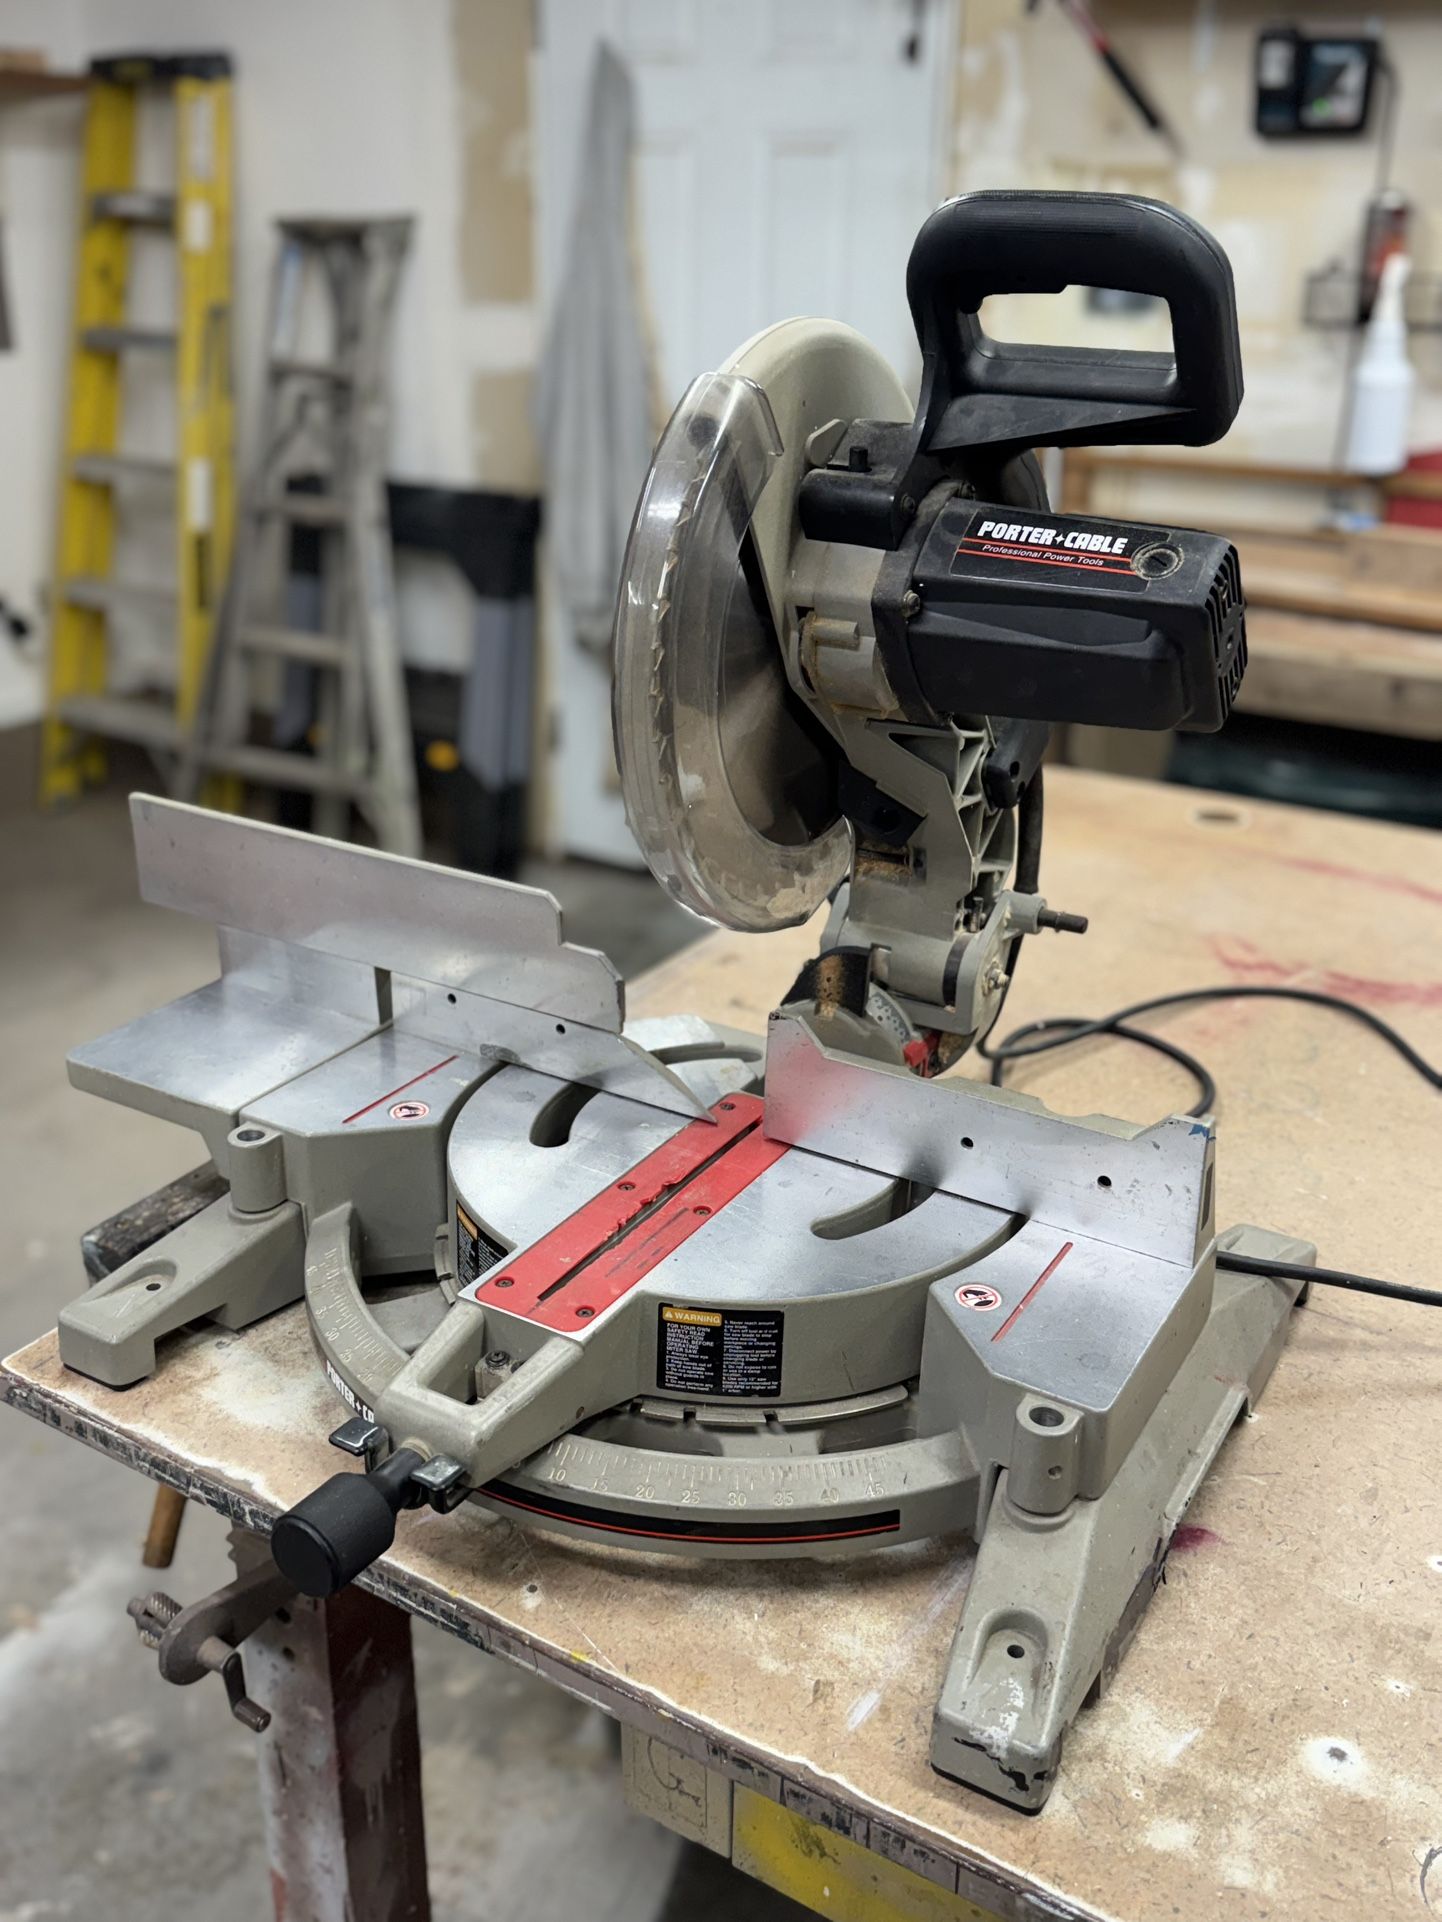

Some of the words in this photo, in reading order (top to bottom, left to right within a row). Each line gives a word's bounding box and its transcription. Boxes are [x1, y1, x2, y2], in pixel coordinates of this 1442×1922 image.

[982, 544, 1040, 558] Professional
[1043, 552, 1074, 562] Power
[1077, 556, 1104, 566] Tools
[674, 1312, 720, 1323] WARNING
[667, 1341, 699, 1350] OPERATING
[548, 1468, 566, 1482] 10
[591, 1478, 608, 1492] 15
[635, 1484, 655, 1499] 20
[681, 1490, 701, 1505] 25
[728, 1492, 747, 1508] 30
[773, 1491, 794, 1506] 35
[820, 1488, 840, 1504] 40
[865, 1483, 885, 1498] 45
